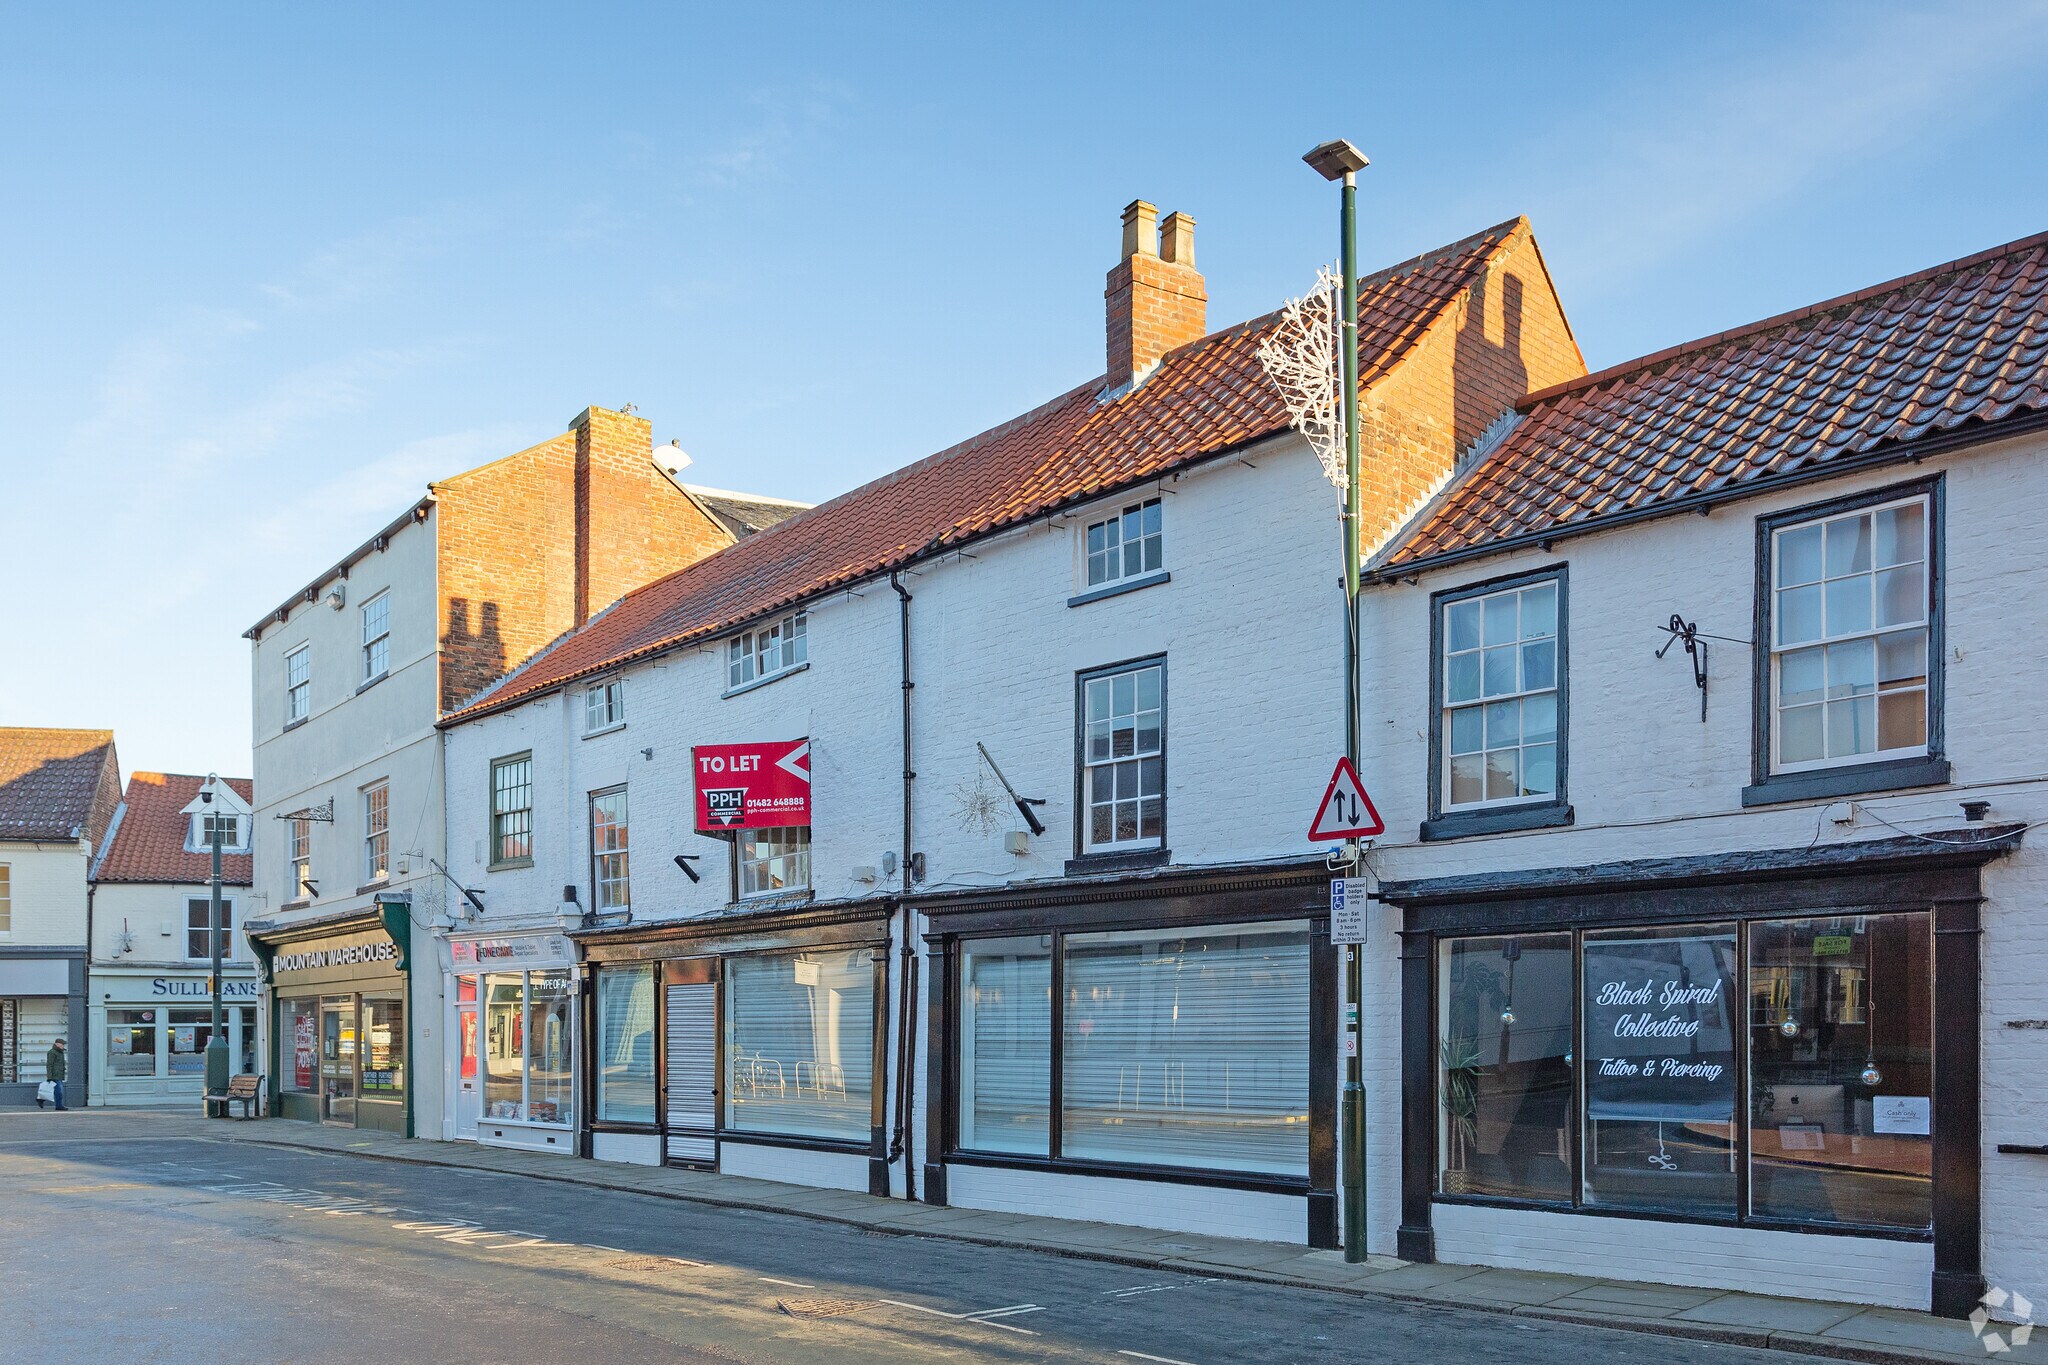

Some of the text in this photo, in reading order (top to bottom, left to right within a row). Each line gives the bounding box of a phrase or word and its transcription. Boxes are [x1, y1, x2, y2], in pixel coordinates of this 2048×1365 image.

[699, 755, 761, 773] TO LET
[709, 792, 741, 807] PPH
[746, 797, 805, 807] 01482 648888
[1335, 882, 1343, 894] P
[279, 941, 394, 972] MOUNTAIN WAREHOUSE
[152, 978, 257, 996] SULLIANS
[1596, 978, 1722, 1012] Black Spiral
[1614, 1012, 1700, 1038] Collective
[1598, 1057, 1723, 1082] Tattoo & Piercing
